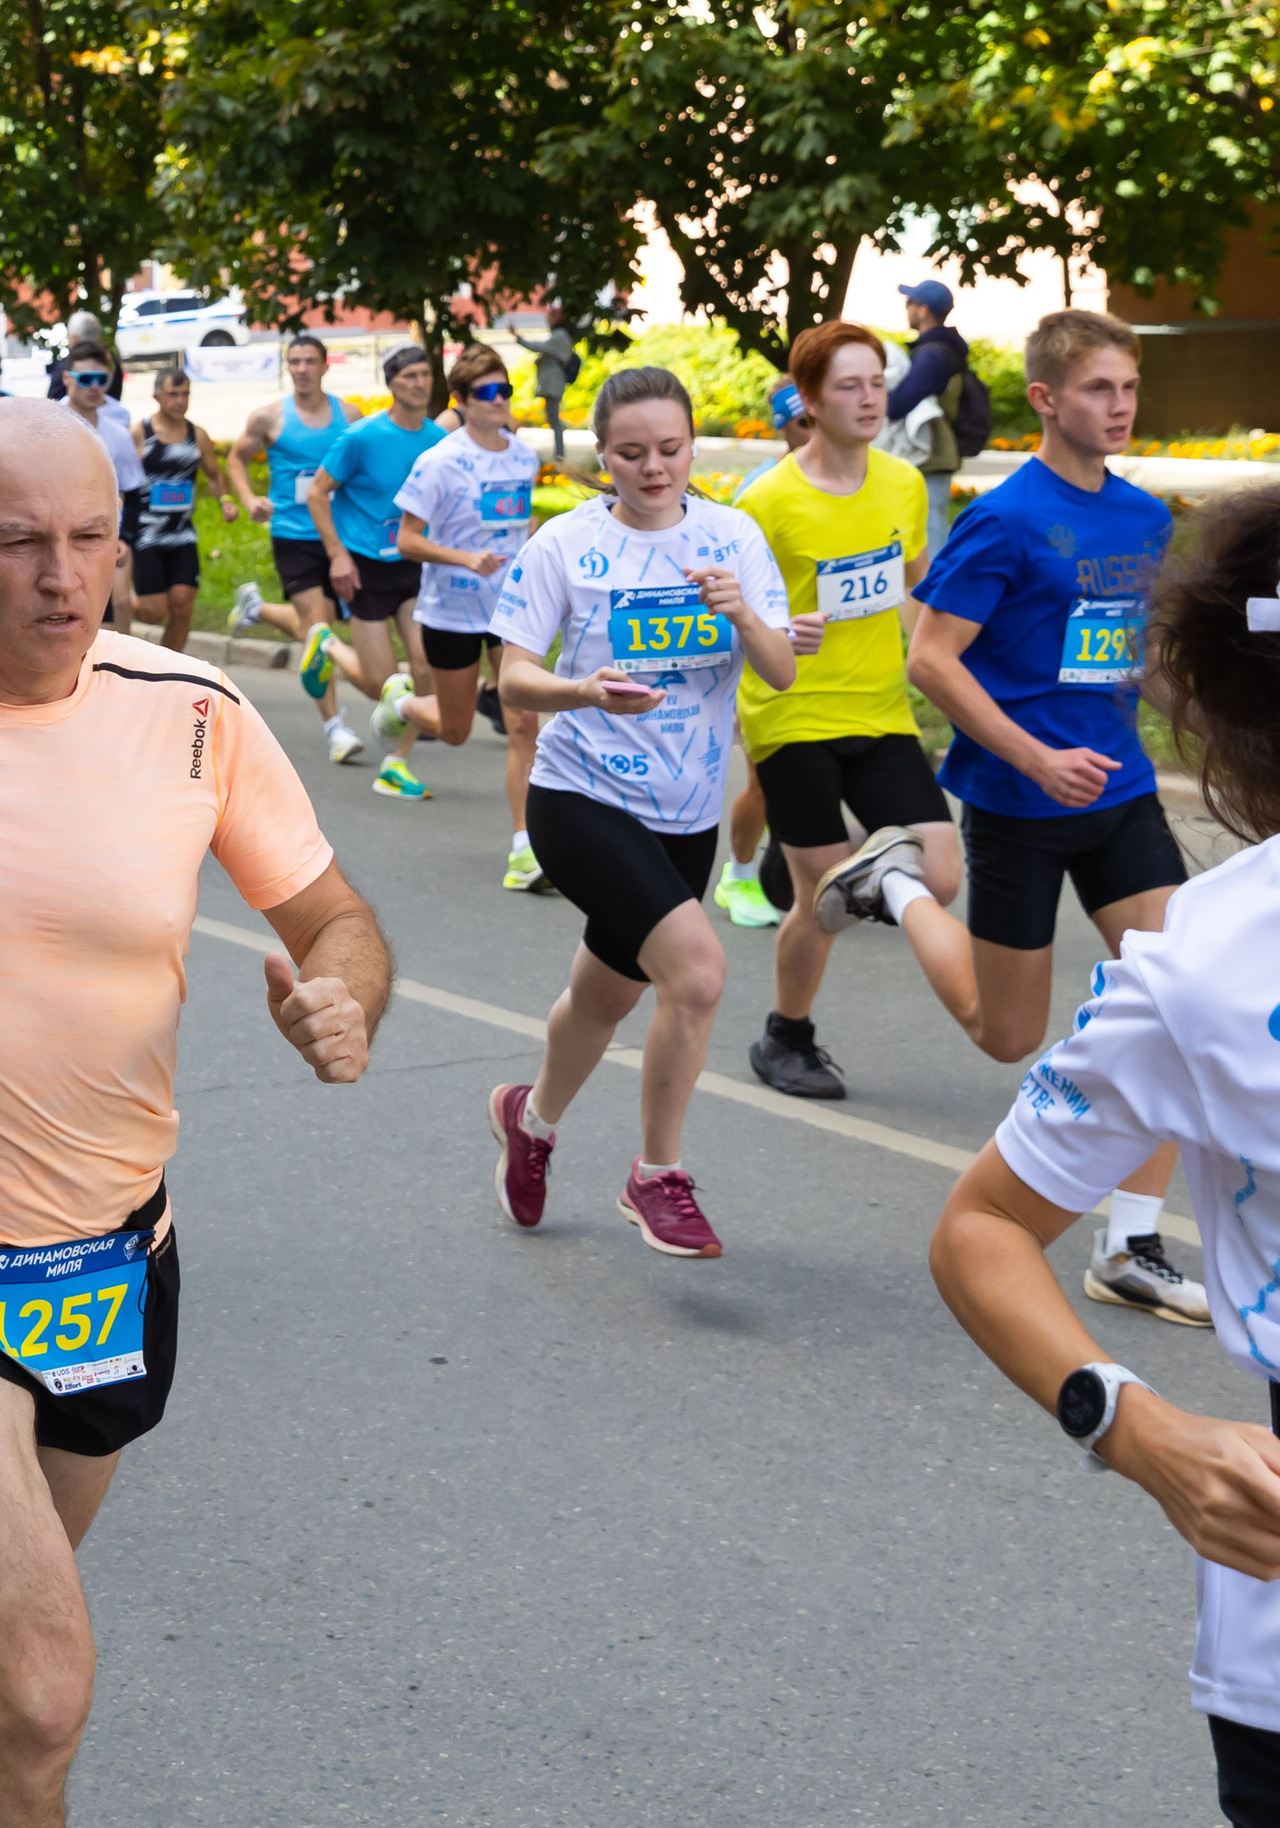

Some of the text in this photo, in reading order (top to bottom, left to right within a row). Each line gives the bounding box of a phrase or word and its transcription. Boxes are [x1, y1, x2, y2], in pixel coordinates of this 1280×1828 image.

[494, 498, 525, 516] 414
[659, 596, 685, 605] МИЛЯ
[840, 570, 888, 603] 216
[627, 613, 719, 651] 1375
[190, 718, 207, 779] Reebok
[1021, 1071, 1056, 1119] СТВЕ
[1038, 1064, 1091, 1121] ЖЕНИИ
[10, 1238, 116, 1268] ДИНАМОВСКАЯ
[46, 1259, 83, 1278] МИЛЯ
